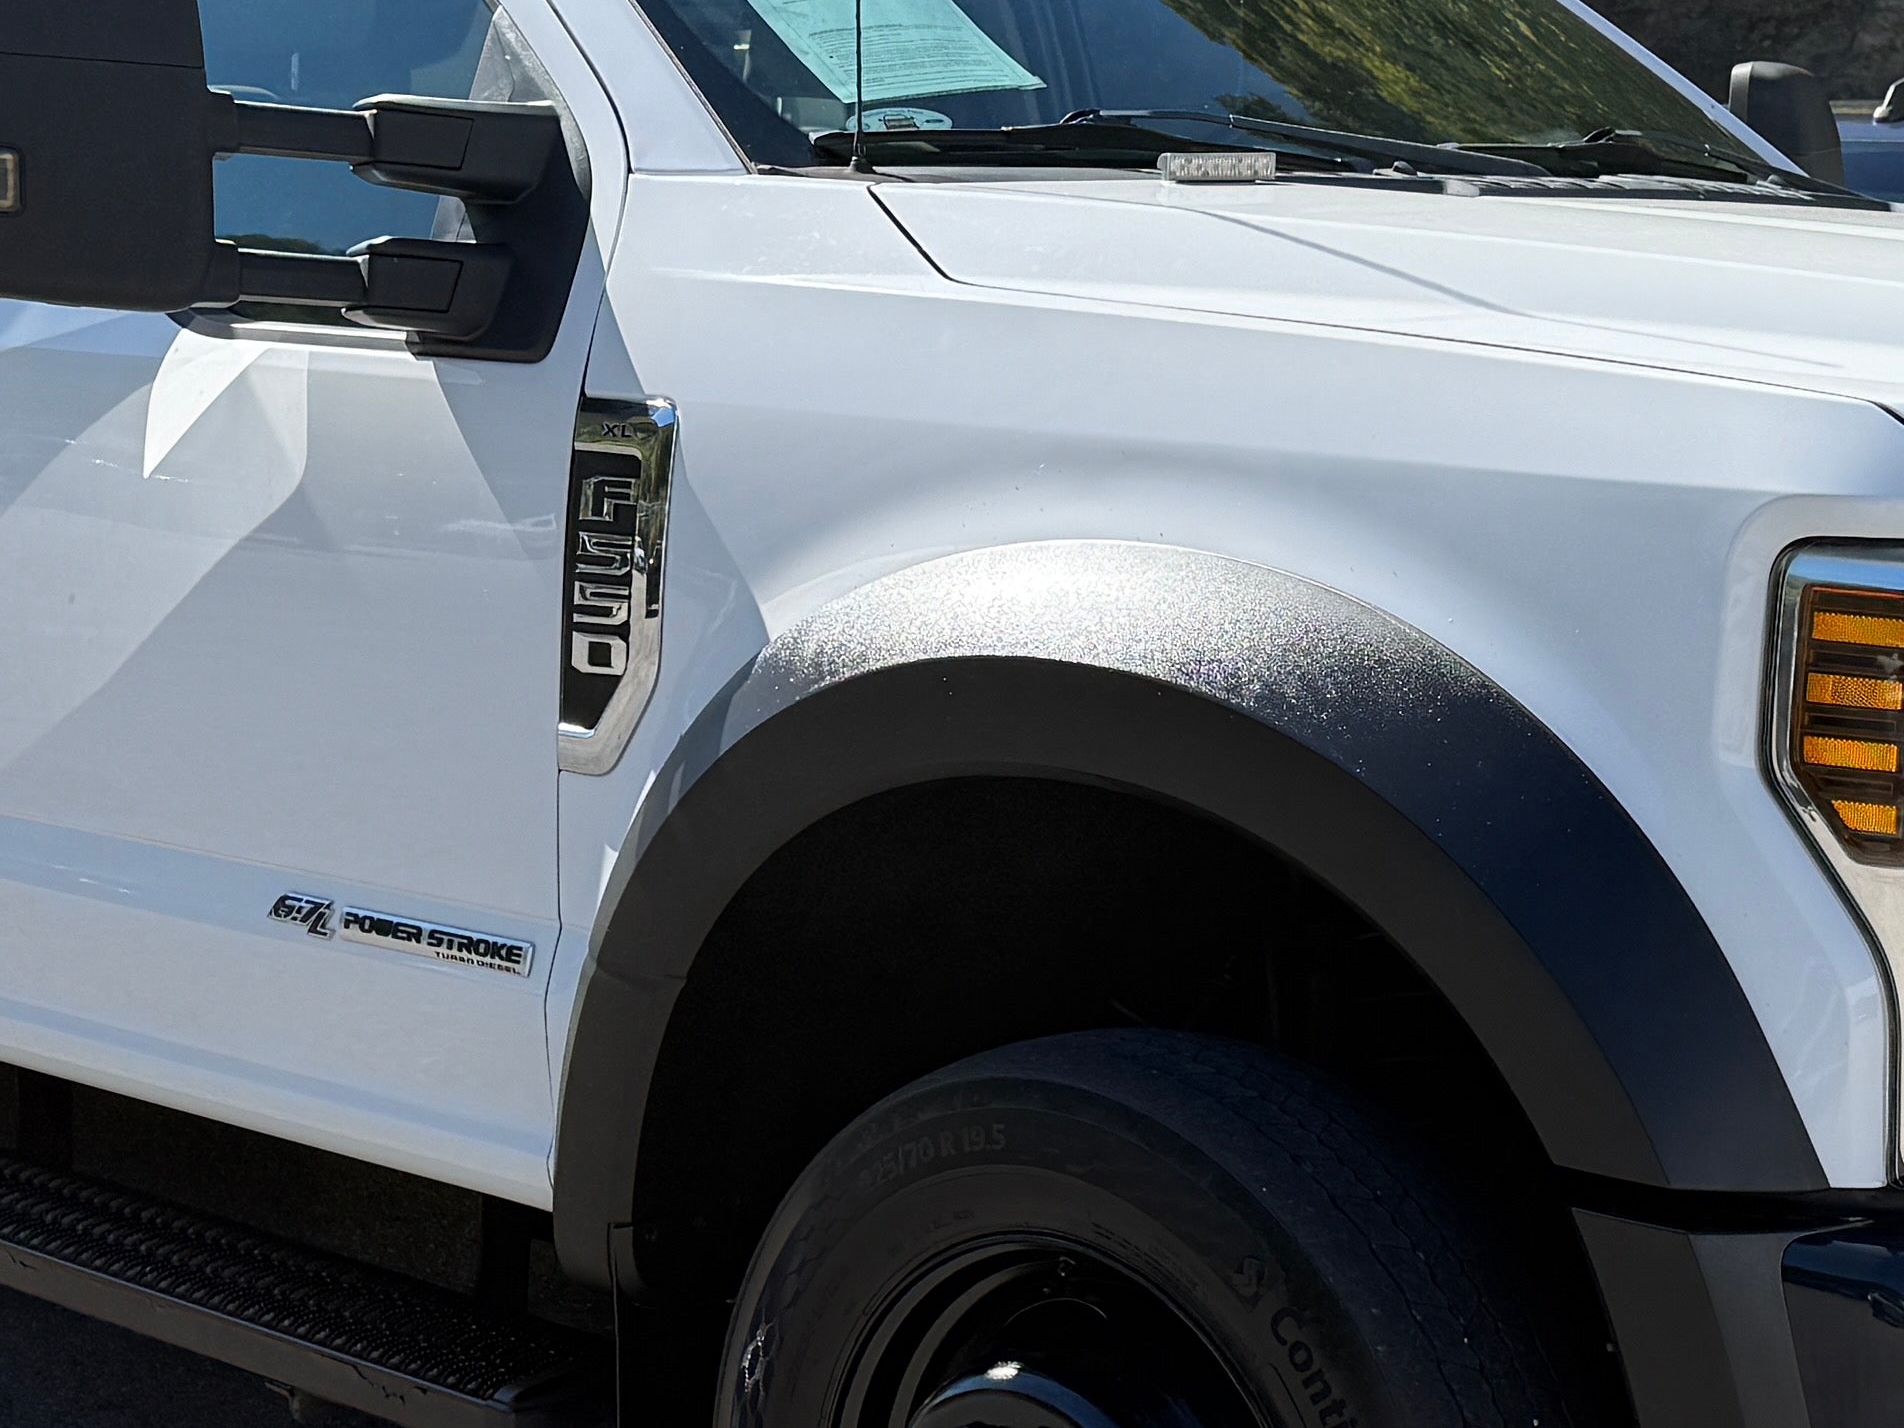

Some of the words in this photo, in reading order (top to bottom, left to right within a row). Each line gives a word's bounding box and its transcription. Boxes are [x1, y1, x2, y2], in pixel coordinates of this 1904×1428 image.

[602, 423, 633, 439] XL
[343, 911, 424, 945] POWER
[426, 928, 524, 965] STROKE
[960, 1123, 1007, 1153] 19.5
